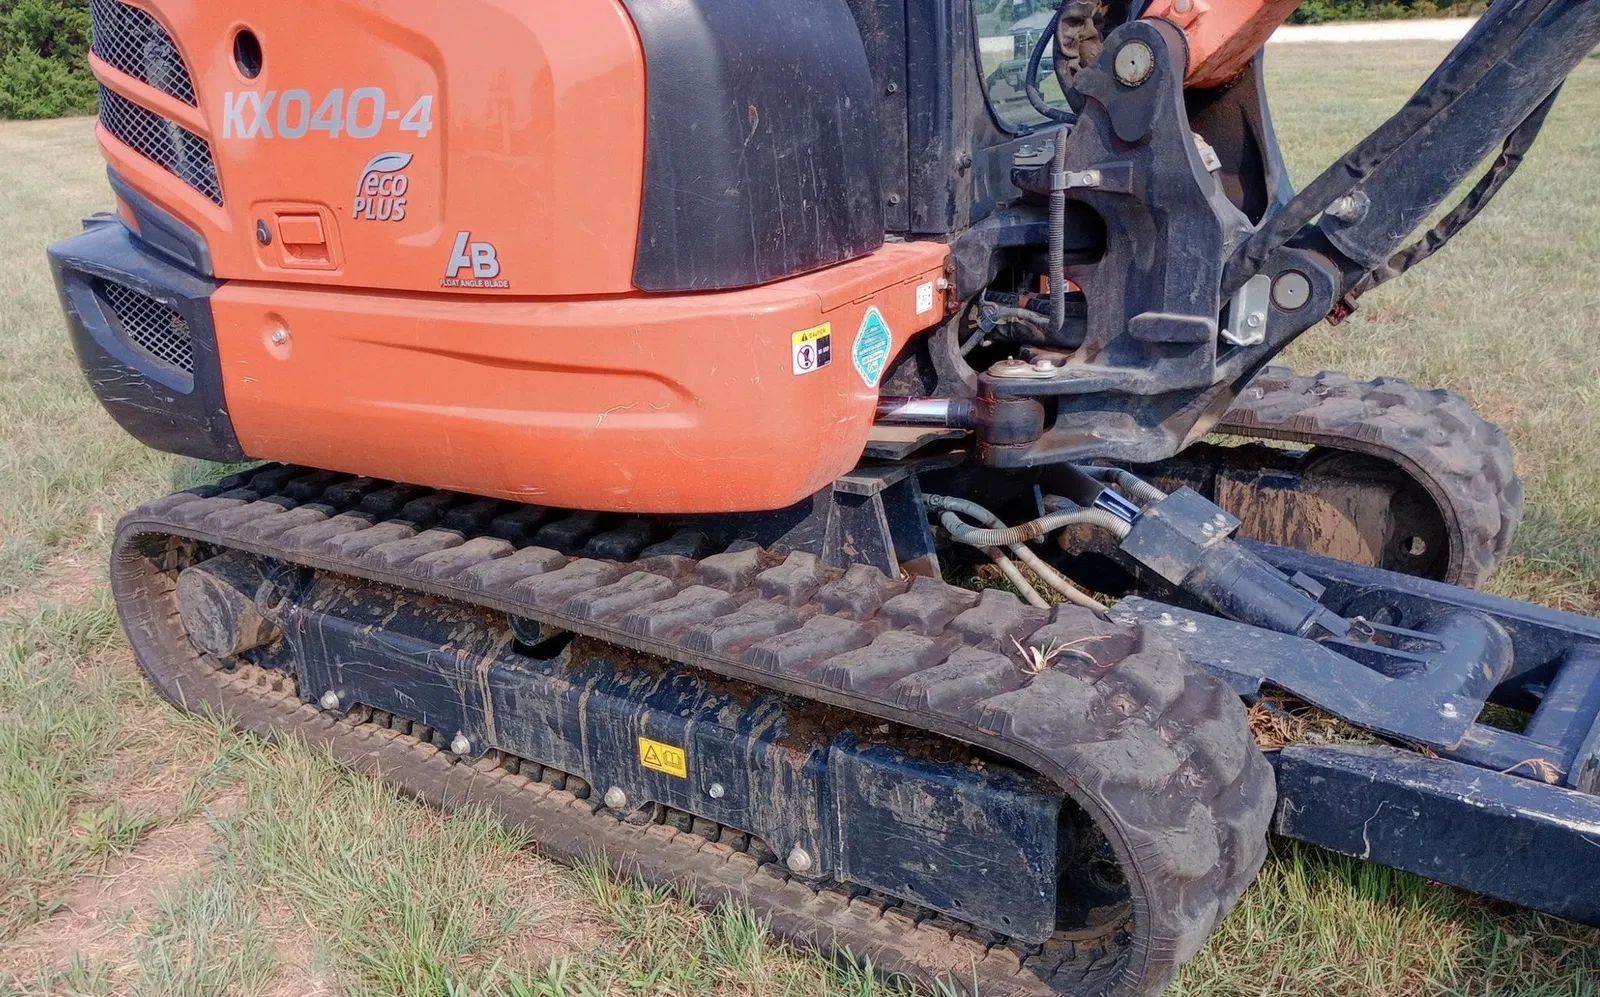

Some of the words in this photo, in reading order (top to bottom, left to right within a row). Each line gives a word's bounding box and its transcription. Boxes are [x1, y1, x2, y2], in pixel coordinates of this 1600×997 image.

[222, 86, 433, 139] KX040-4
[364, 173, 409, 197] eco
[353, 197, 408, 222] PLUS
[440, 279, 460, 288] FLOAT
[460, 279, 484, 289] ANGLE
[484, 280, 510, 289] BLADE
